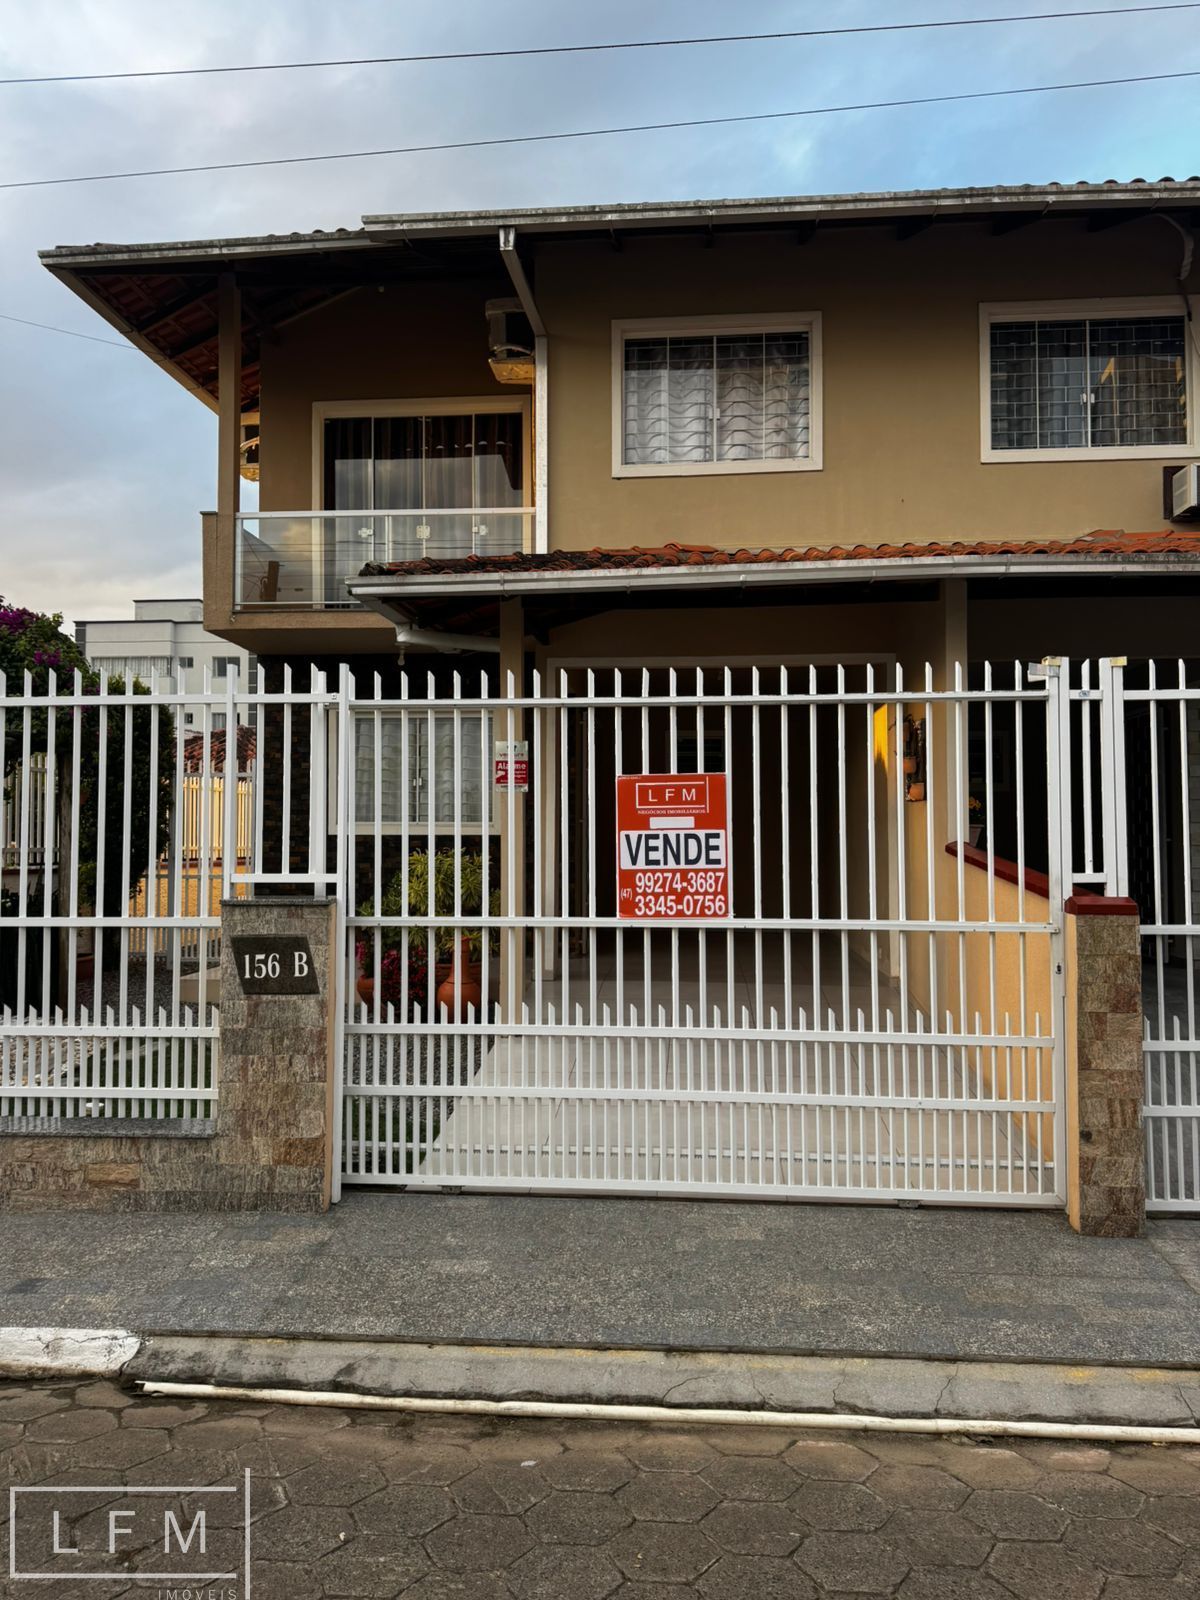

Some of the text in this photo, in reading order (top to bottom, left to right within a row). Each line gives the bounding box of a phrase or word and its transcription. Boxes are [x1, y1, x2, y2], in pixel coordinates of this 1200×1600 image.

[624, 832, 722, 866] VENDE
[635, 872, 725, 893] 99274-3687
[620, 888, 633, 901] (47)
[634, 895, 726, 916] 3345-0756
[244, 951, 309, 979] 156 B
